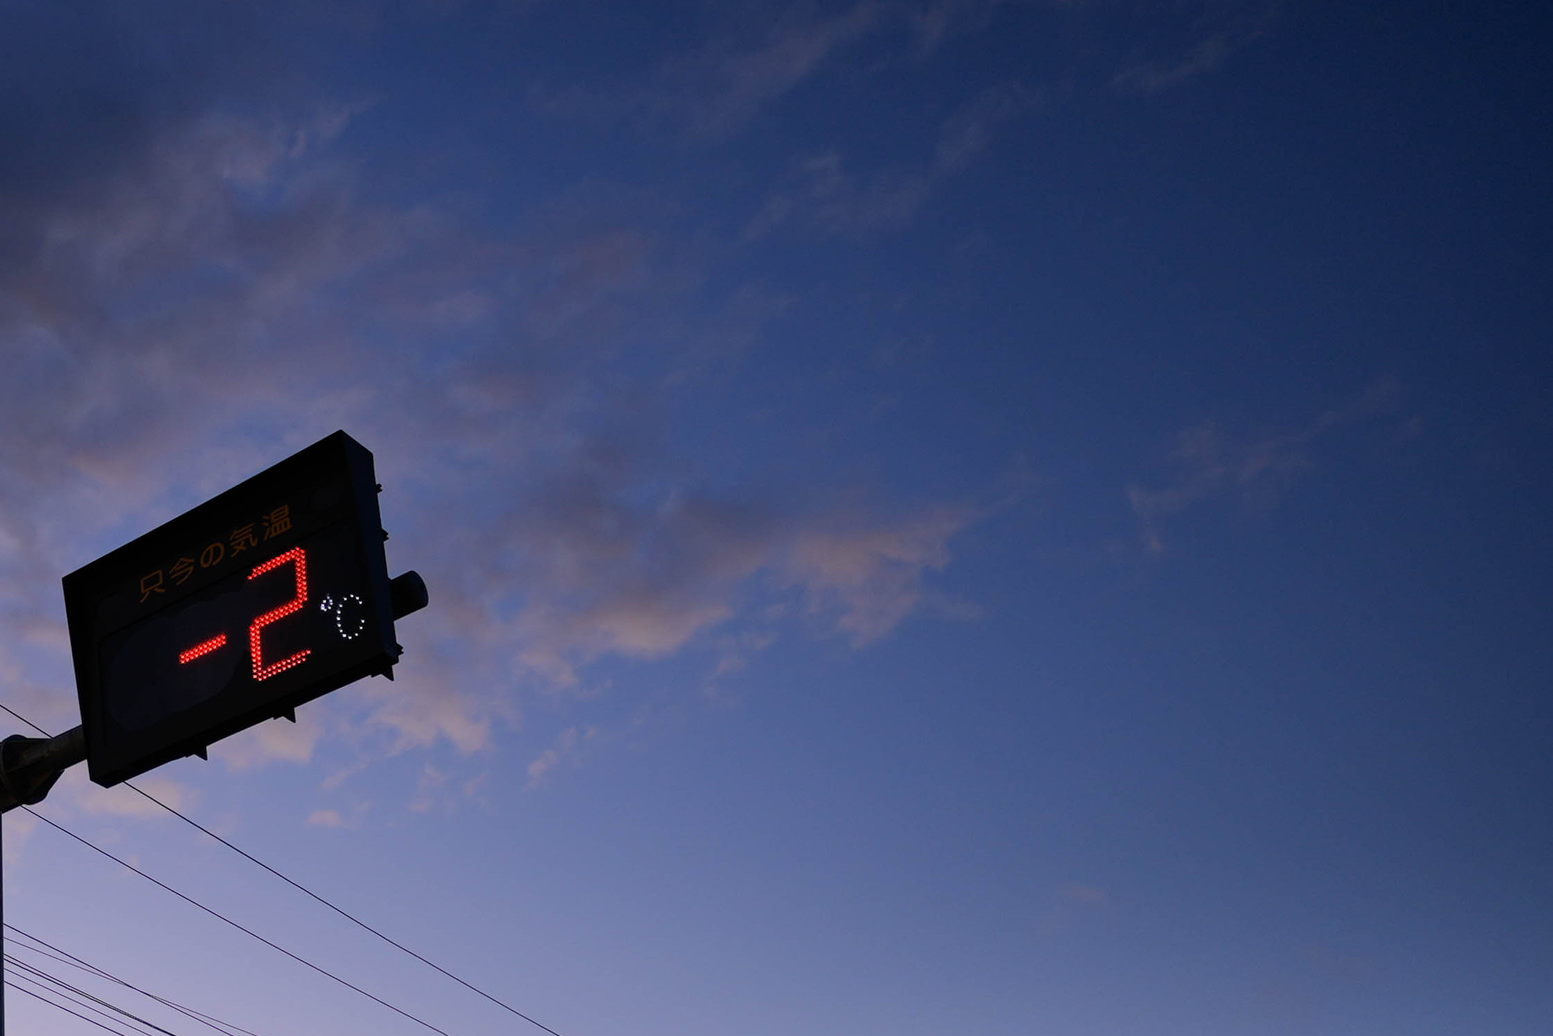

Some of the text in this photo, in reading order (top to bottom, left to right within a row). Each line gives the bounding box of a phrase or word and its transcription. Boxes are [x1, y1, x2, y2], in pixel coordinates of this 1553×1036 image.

[140, 504, 294, 603] 只今の気温
